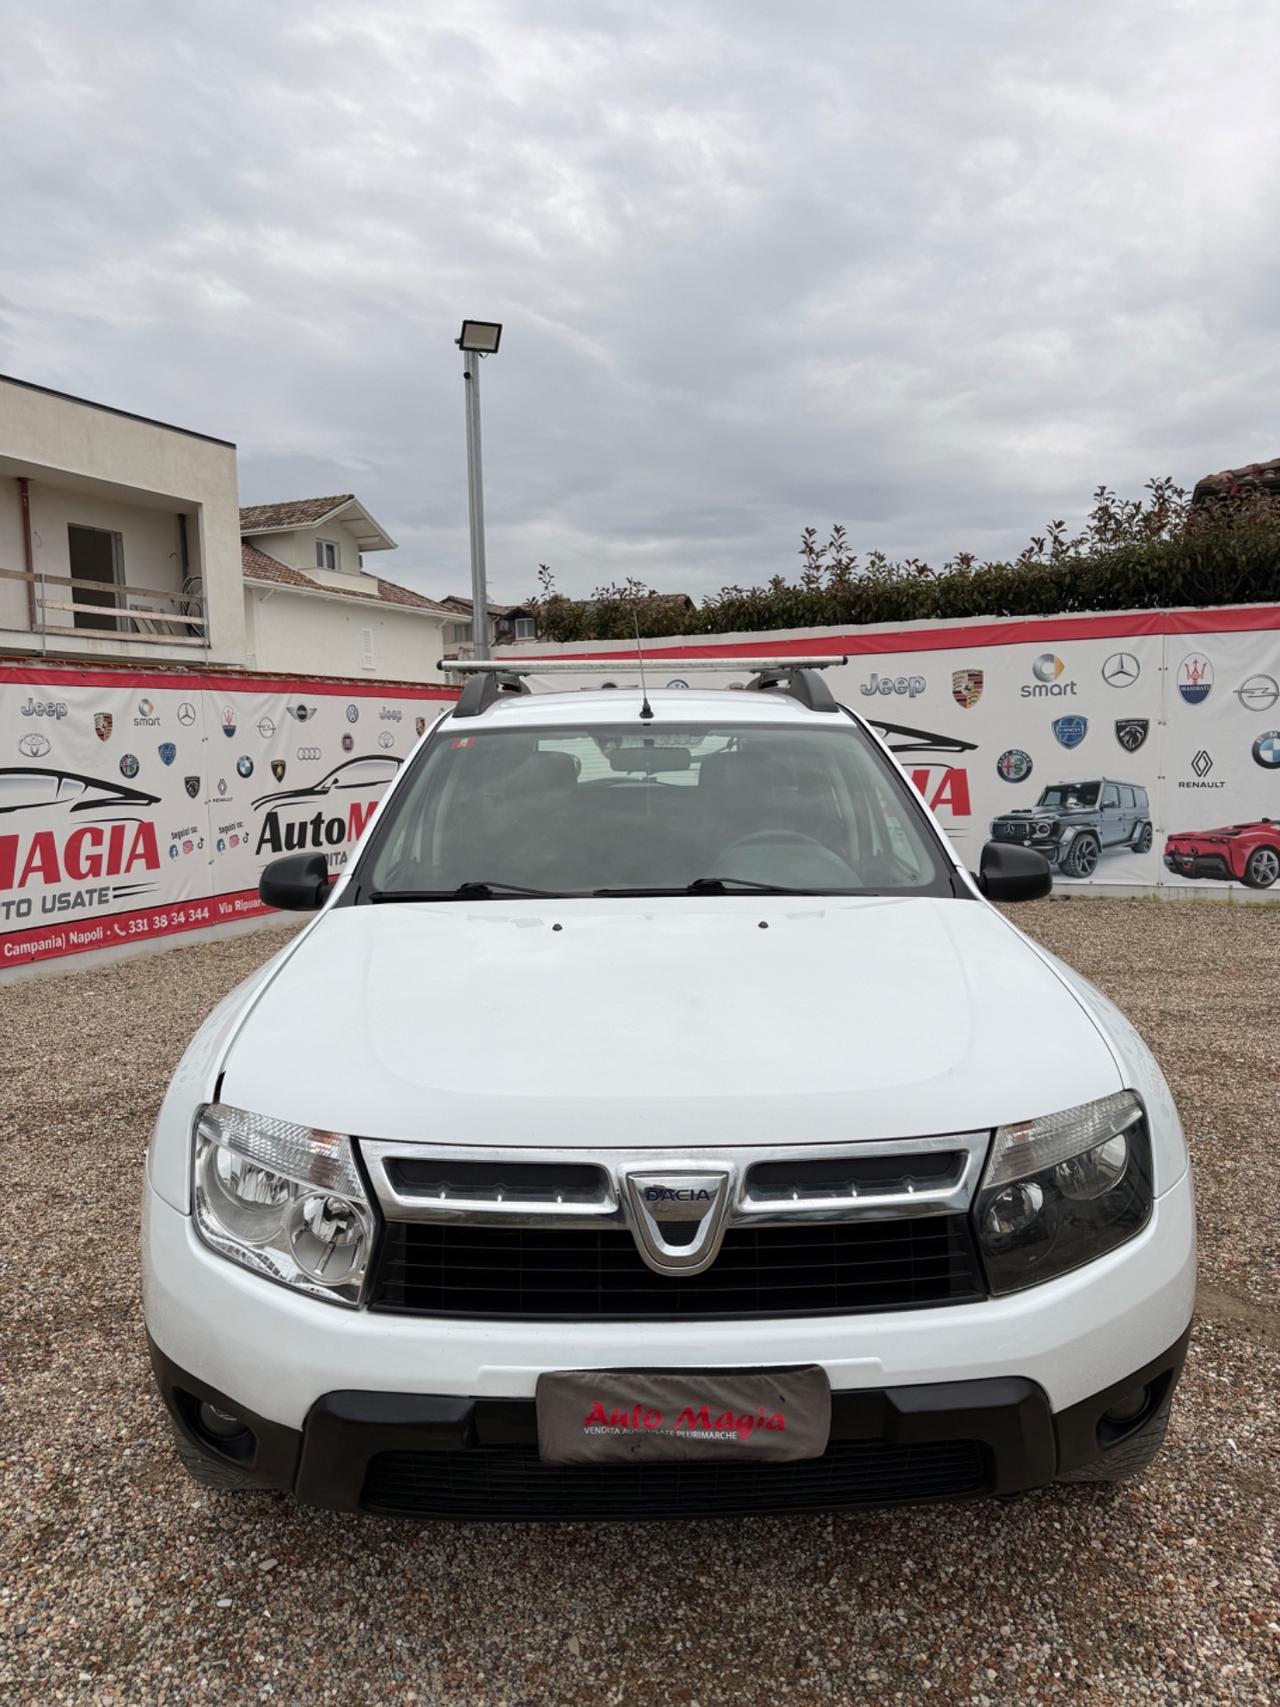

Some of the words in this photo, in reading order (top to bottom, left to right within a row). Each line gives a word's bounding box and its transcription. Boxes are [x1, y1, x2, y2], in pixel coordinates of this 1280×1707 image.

[860, 673, 926, 697] Jeep
[1021, 681, 1077, 697] smart
[20, 698, 68, 720] Jeep
[379, 706, 402, 722] Jeep
[133, 717, 161, 727] smart
[41, 886, 111, 914] USATE
[219, 902, 233, 914] Via
[4, 933, 67, 957] Campania)
[69, 926, 104, 945] Napoli
[128, 918, 149, 934] 331
[153, 914, 168, 929] 38
[171, 911, 186, 926] 34
[189, 907, 210, 922] 344
[645, 1188, 710, 1201] DACIA
[583, 1401, 663, 1430] Auto
[671, 1403, 785, 1439] Magia
[583, 1426, 621, 1435] VENDITA
